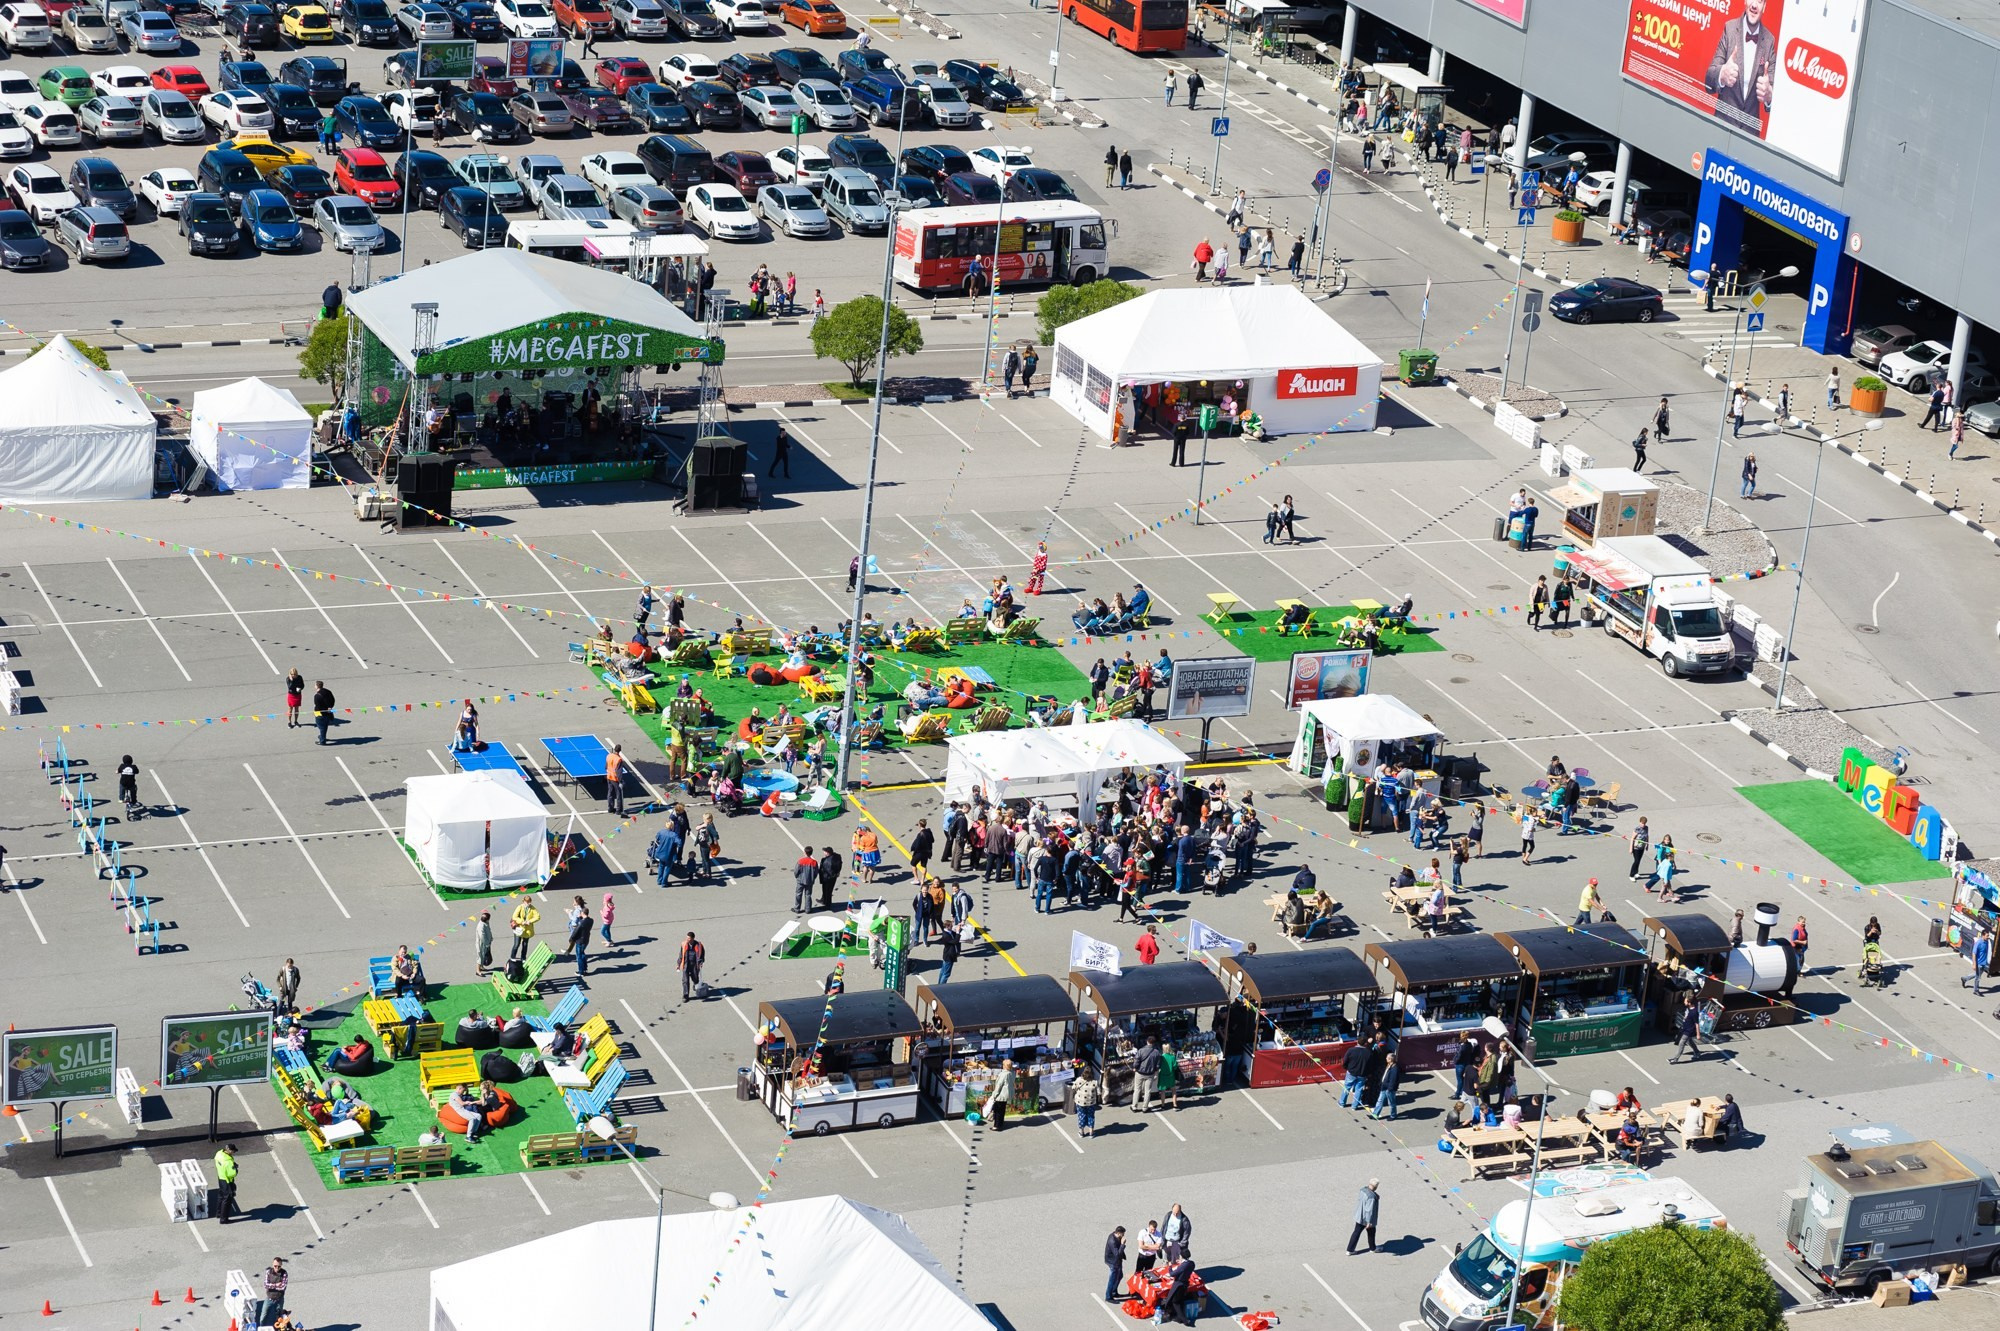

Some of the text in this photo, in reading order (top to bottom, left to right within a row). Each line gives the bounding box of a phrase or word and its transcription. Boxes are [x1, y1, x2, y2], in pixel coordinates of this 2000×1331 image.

[1682, 5, 1711, 31] цену!
[1644, 13, 1680, 48] 1000
[446, 44, 474, 62] SALE
[1787, 46, 1845, 88] М.видео
[1706, 162, 1839, 241] добро пожаловать
[489, 332, 650, 364] #MEGAFEST
[1289, 373, 1346, 394] Ашан
[504, 469, 577, 485] #MEGAFEST
[1178, 668, 1249, 682] НОВАЯ БЕСПЛАТНАЯ
[217, 1021, 269, 1053] SALE
[1553, 1026, 1619, 1043] THE BOTTLE SHOP
[59, 1037, 112, 1071] SALE
[217, 1058, 230, 1067] ЭТО
[60, 1073, 74, 1082] ЭТО
